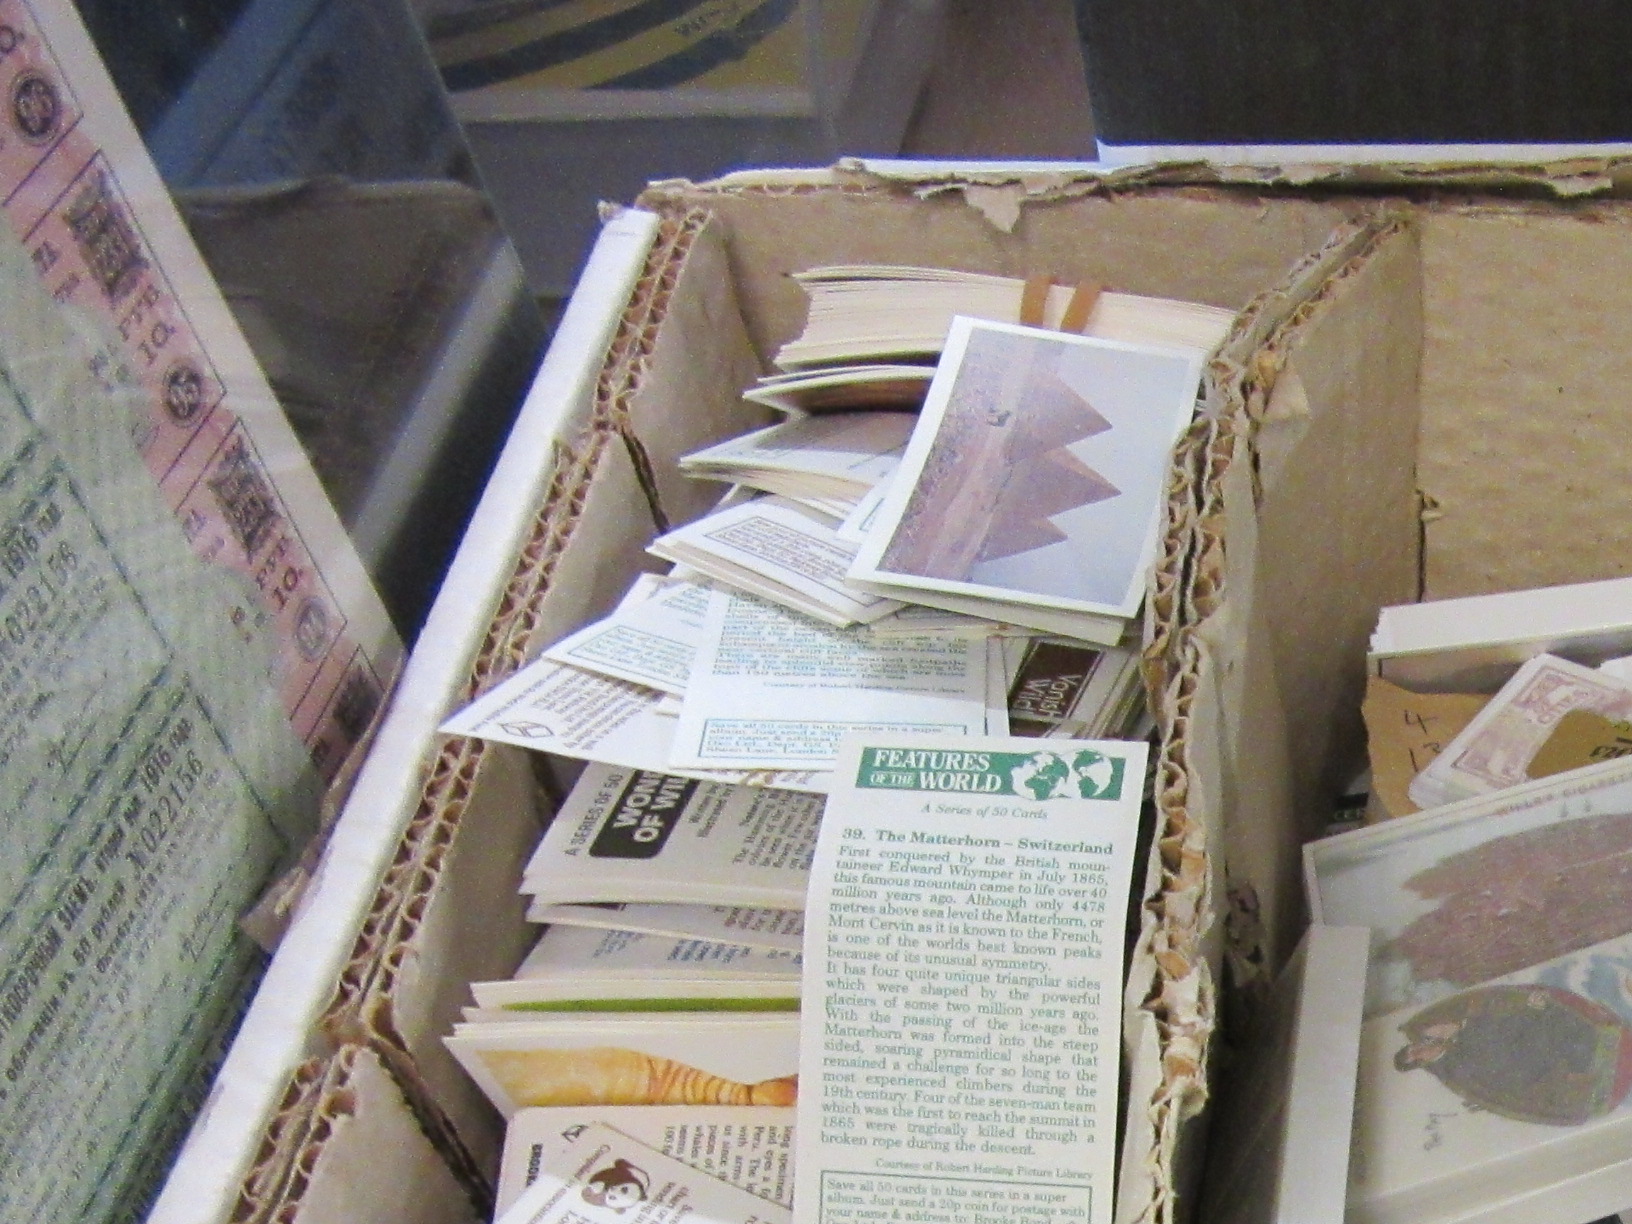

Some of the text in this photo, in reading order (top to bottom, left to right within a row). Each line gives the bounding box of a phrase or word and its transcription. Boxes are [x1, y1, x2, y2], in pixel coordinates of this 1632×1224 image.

[872, 748, 990, 773] FEATURES
[870, 770, 1002, 793] OF THE WORLD
[921, 802, 1048, 821] A Series of 50 Cards
[633, 814, 666, 840] OF
[842, 828, 1113, 855] 39. The Matterhorn Switzerland
[836, 858, 1108, 886] taineer Edward Whymper in July 1865,
[839, 845, 1109, 872] First conquered by the British moun-
[832, 885, 1105, 913] million years ago. Although only 4478
[834, 872, 1107, 899] this famous mountain came to life over 40
[830, 900, 1104, 928] metres above sea level the Matterhorn, or
[828, 915, 1102, 944] Mont Cervin as it is known to the French,
[827, 930, 1102, 962] is one of the worlds best known peaks
